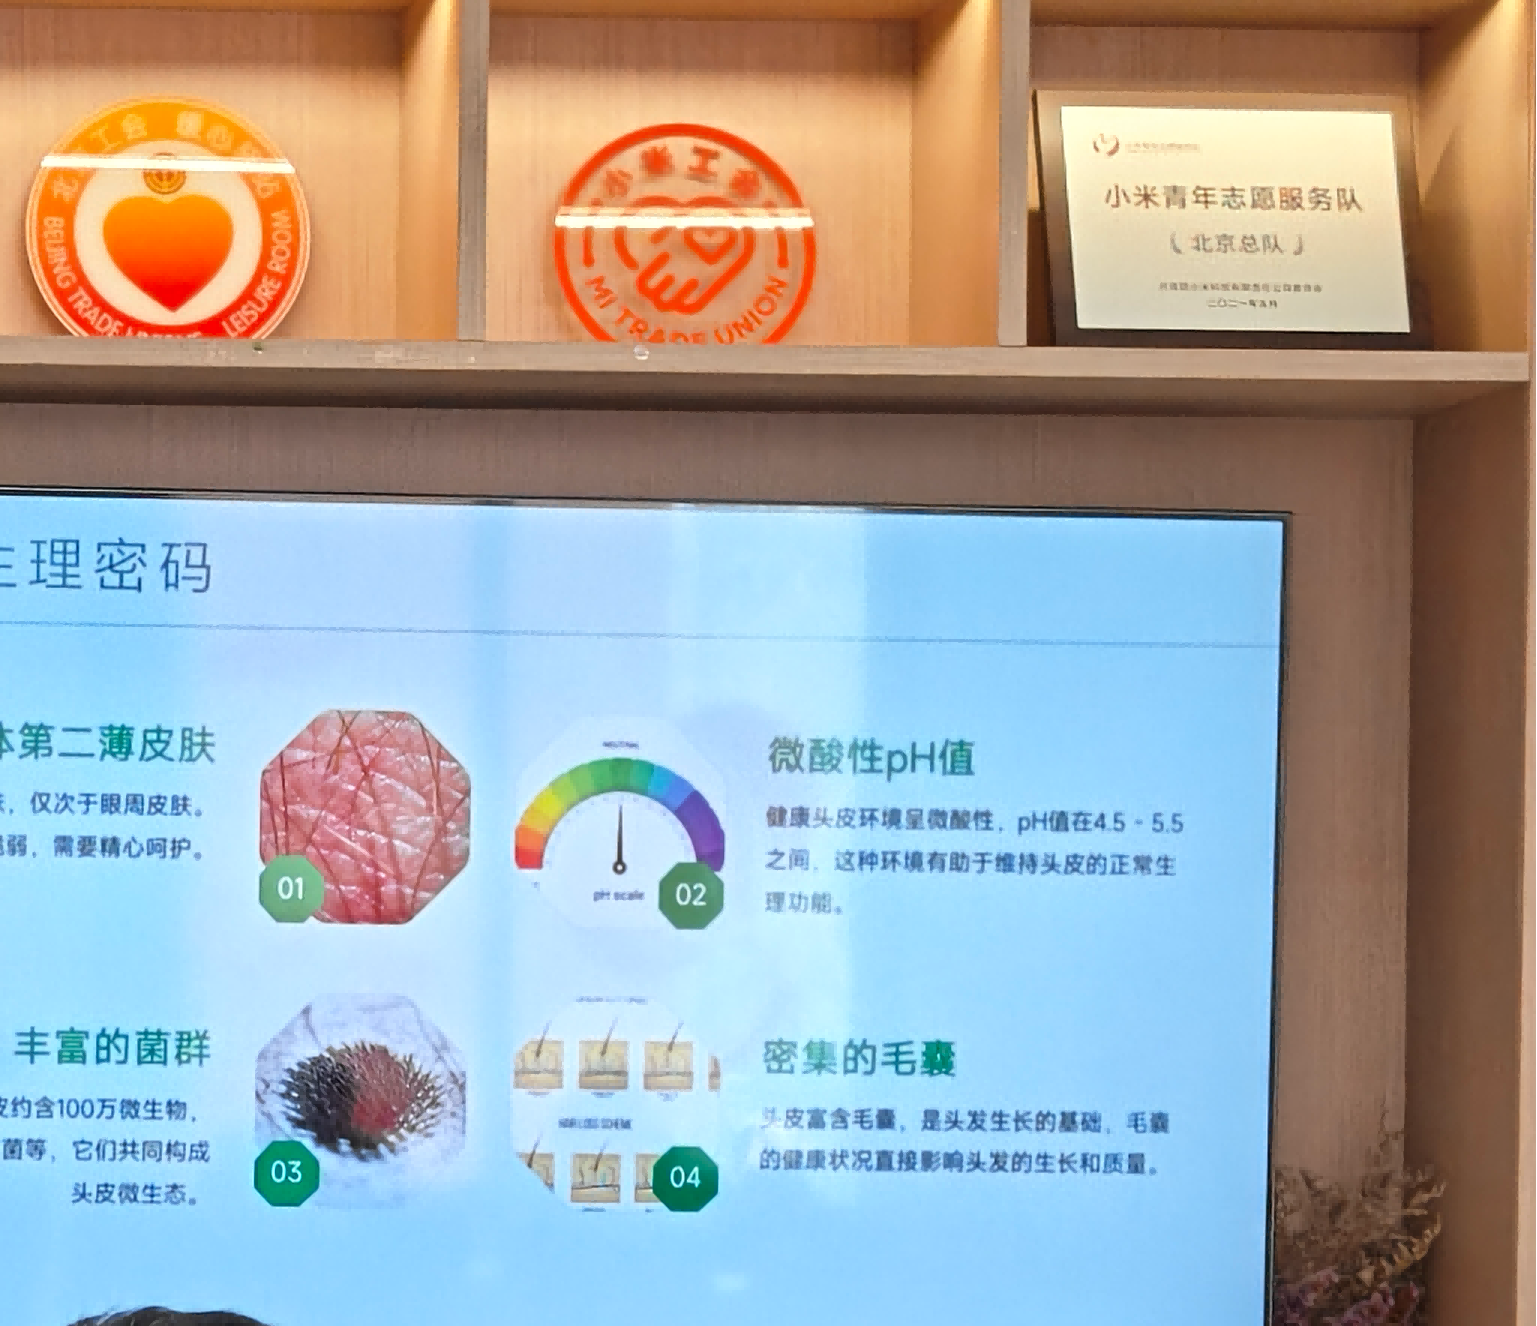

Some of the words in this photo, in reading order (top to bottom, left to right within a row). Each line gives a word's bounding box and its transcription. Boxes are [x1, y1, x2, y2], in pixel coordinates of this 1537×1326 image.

[1104, 183, 1365, 213] 小米青年志愿服务队
[42, 215, 78, 290] BEIJING
[220, 275, 284, 340] LEISURE
[265, 208, 294, 276] ROOM
[584, 274, 619, 311] MI
[712, 274, 790, 346] UNION
[766, 735, 977, 782] 微酸性pH值
[763, 847, 1178, 878] 之间，这种环境有助于维持头皮的正常生
[276, 873, 306, 901] 01
[675, 882, 707, 907] 02
[764, 889, 845, 917] 理功能。
[13, 1025, 212, 1068] 丰富的菌群
[762, 1037, 957, 1079] 密集的毛囊
[270, 1159, 303, 1184] 03
[669, 1164, 702, 1190] 04
[759, 1147, 1159, 1177] 的健康状况直接影响头发的生长和质量。
[70, 1181, 198, 1207] 头皮微生态。
